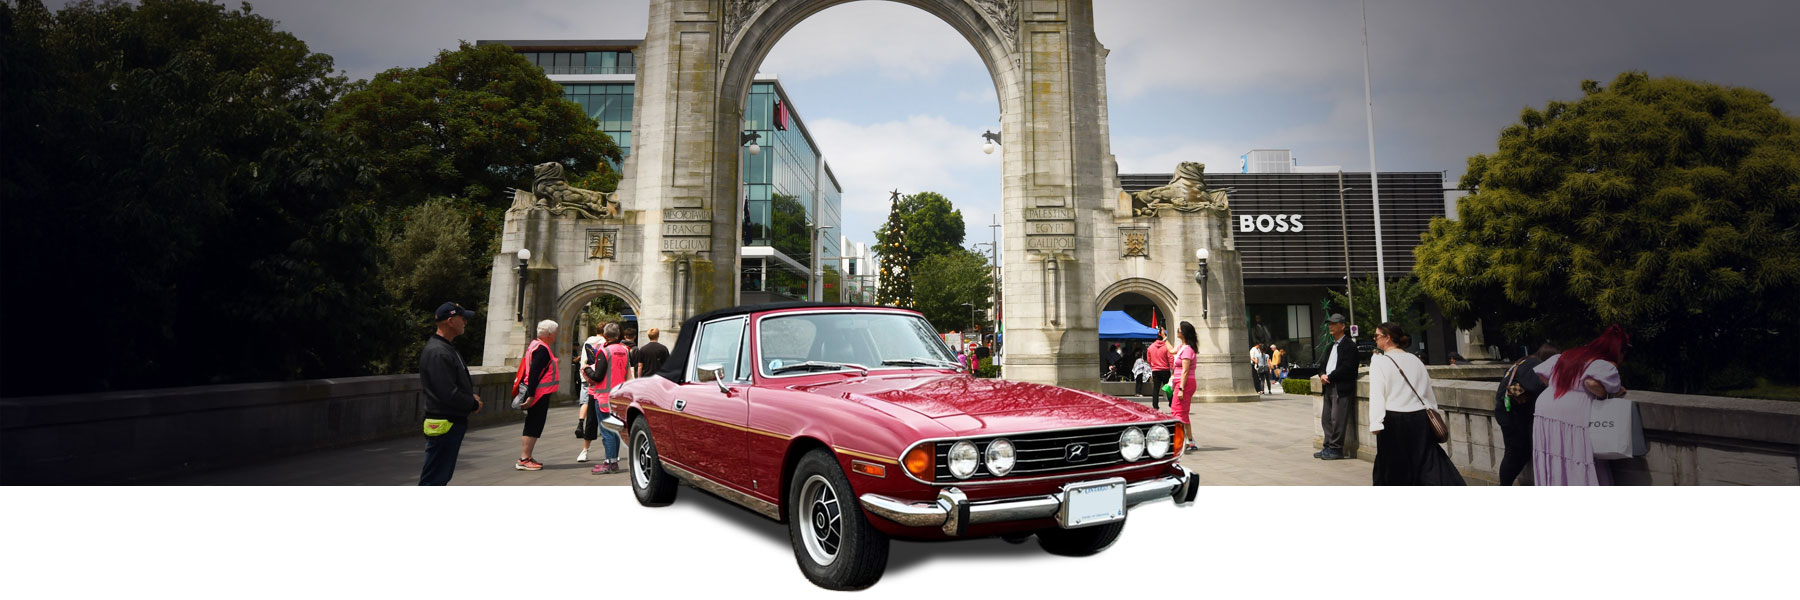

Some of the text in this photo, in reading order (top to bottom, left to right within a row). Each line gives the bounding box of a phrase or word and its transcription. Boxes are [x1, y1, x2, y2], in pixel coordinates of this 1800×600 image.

[1030, 209, 1073, 219] PALESTINE
[1035, 223, 1064, 233] EGYPT
[1239, 214, 1304, 233] BOSS
[667, 224, 706, 234] FRANCE
[663, 239, 708, 250] BELGIUM
[1027, 237, 1074, 248] GALLIPOLI
[1588, 420, 1615, 428] rocs
